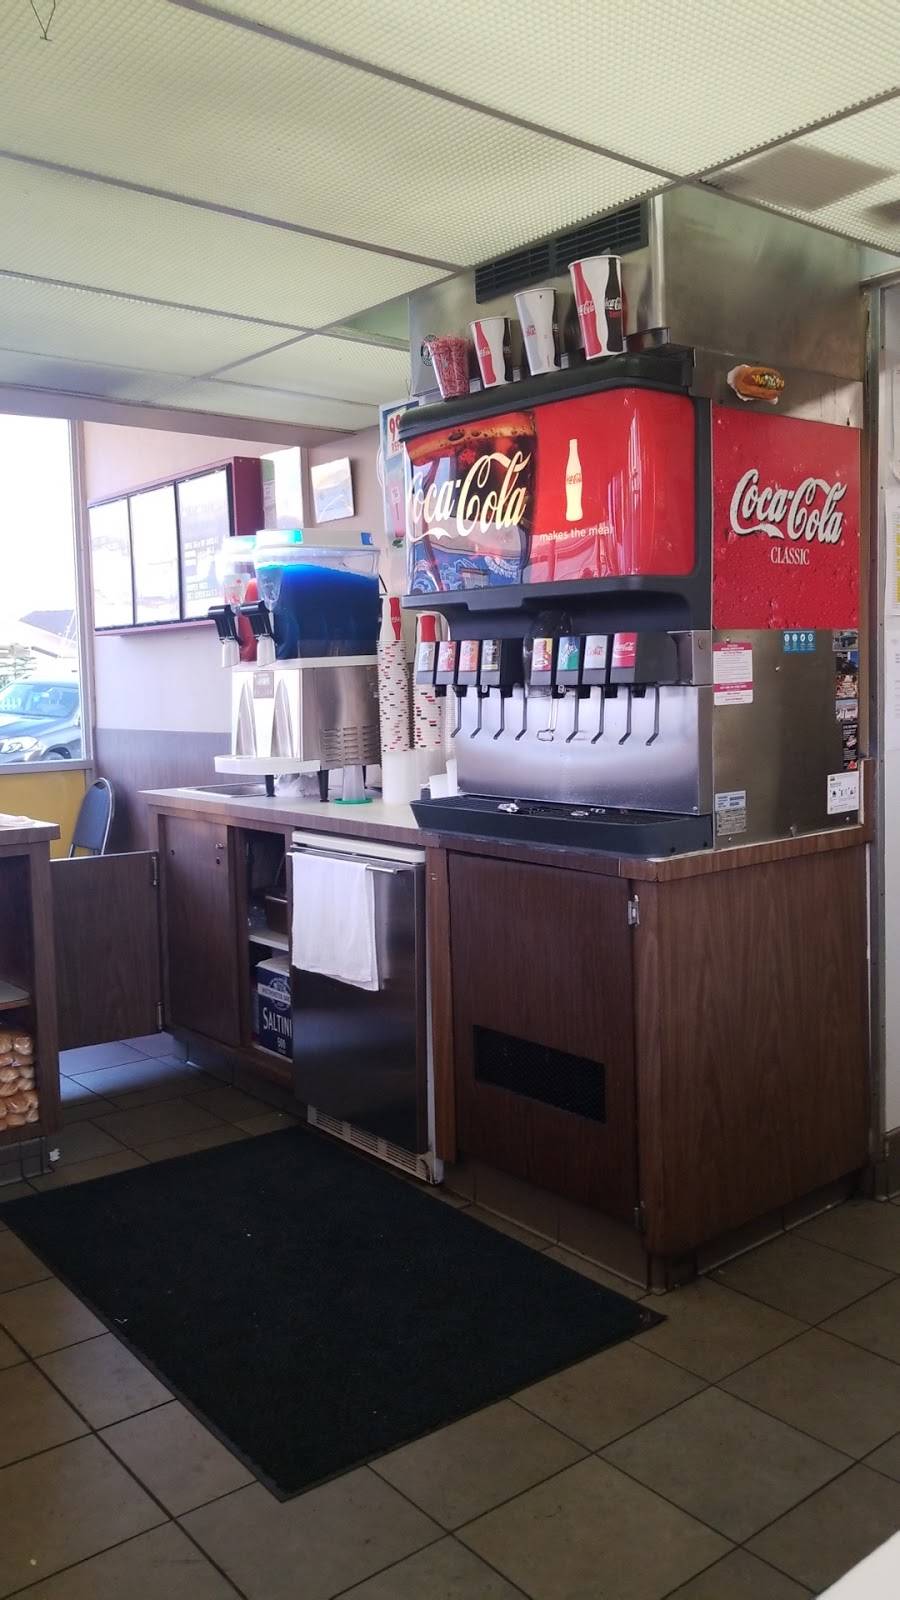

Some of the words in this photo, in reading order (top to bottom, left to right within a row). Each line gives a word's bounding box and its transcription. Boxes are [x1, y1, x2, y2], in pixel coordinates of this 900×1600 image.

[405, 451, 531, 542] Coca-Cola
[730, 468, 847, 543] Coca-Cola
[540, 530, 569, 542] makes
[570, 527, 586, 539] the
[588, 522, 613, 536] meal
[770, 546, 810, 566] CLASSIC
